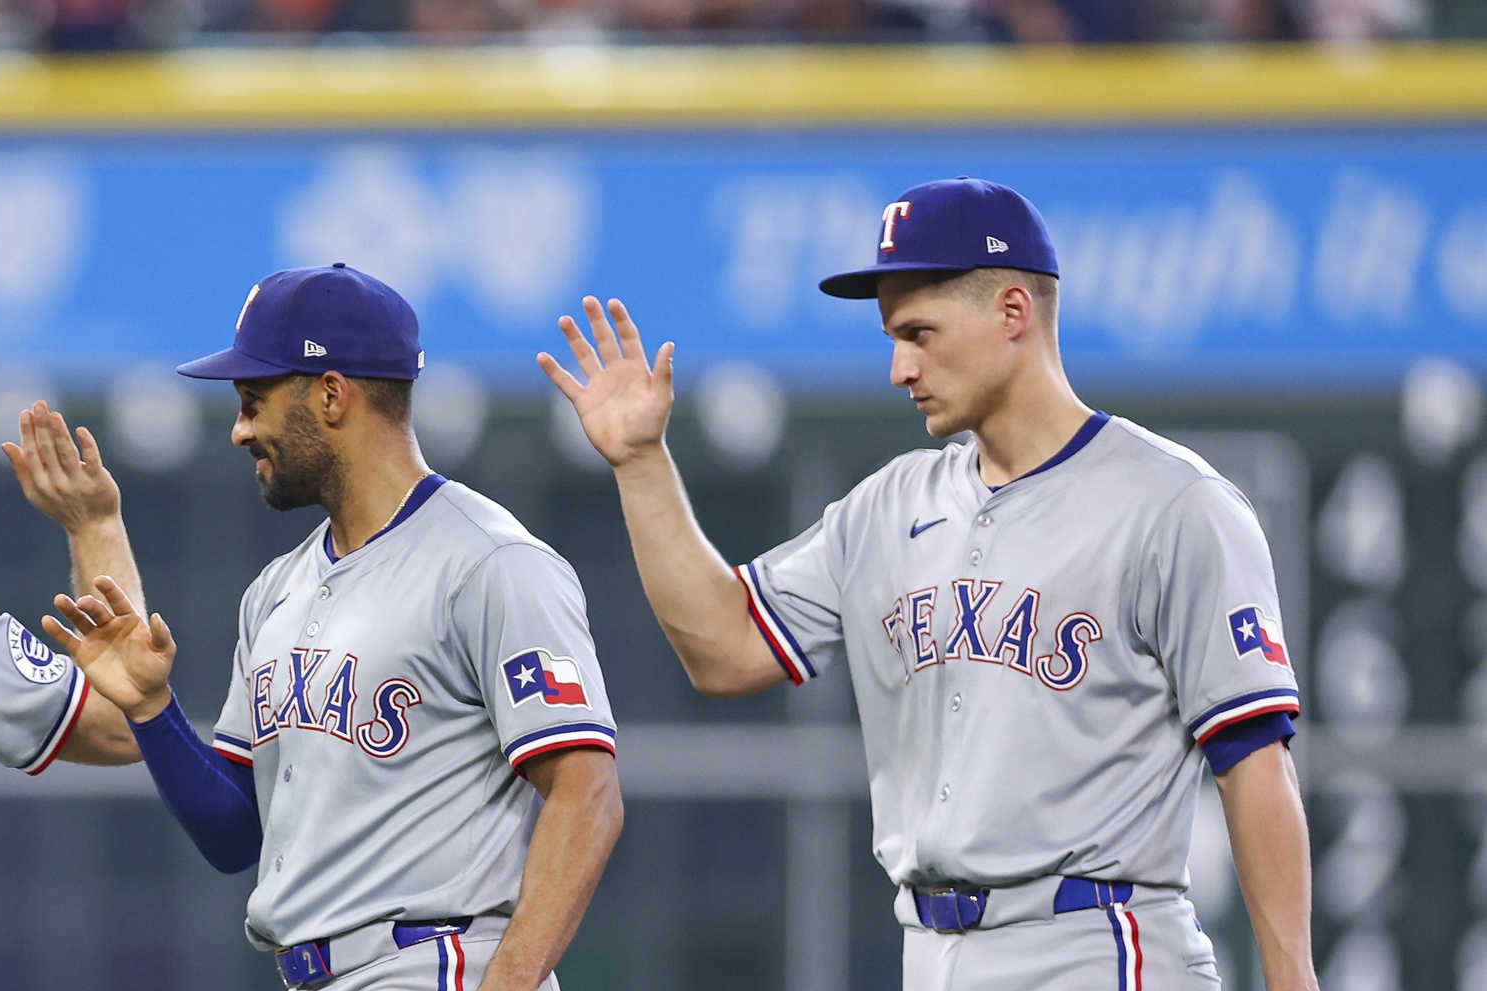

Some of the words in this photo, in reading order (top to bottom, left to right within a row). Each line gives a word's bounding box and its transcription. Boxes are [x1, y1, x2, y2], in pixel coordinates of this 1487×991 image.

[880, 201, 913, 253] T
[247, 647, 423, 759] EXAS
[302, 950, 316, 975] 2
